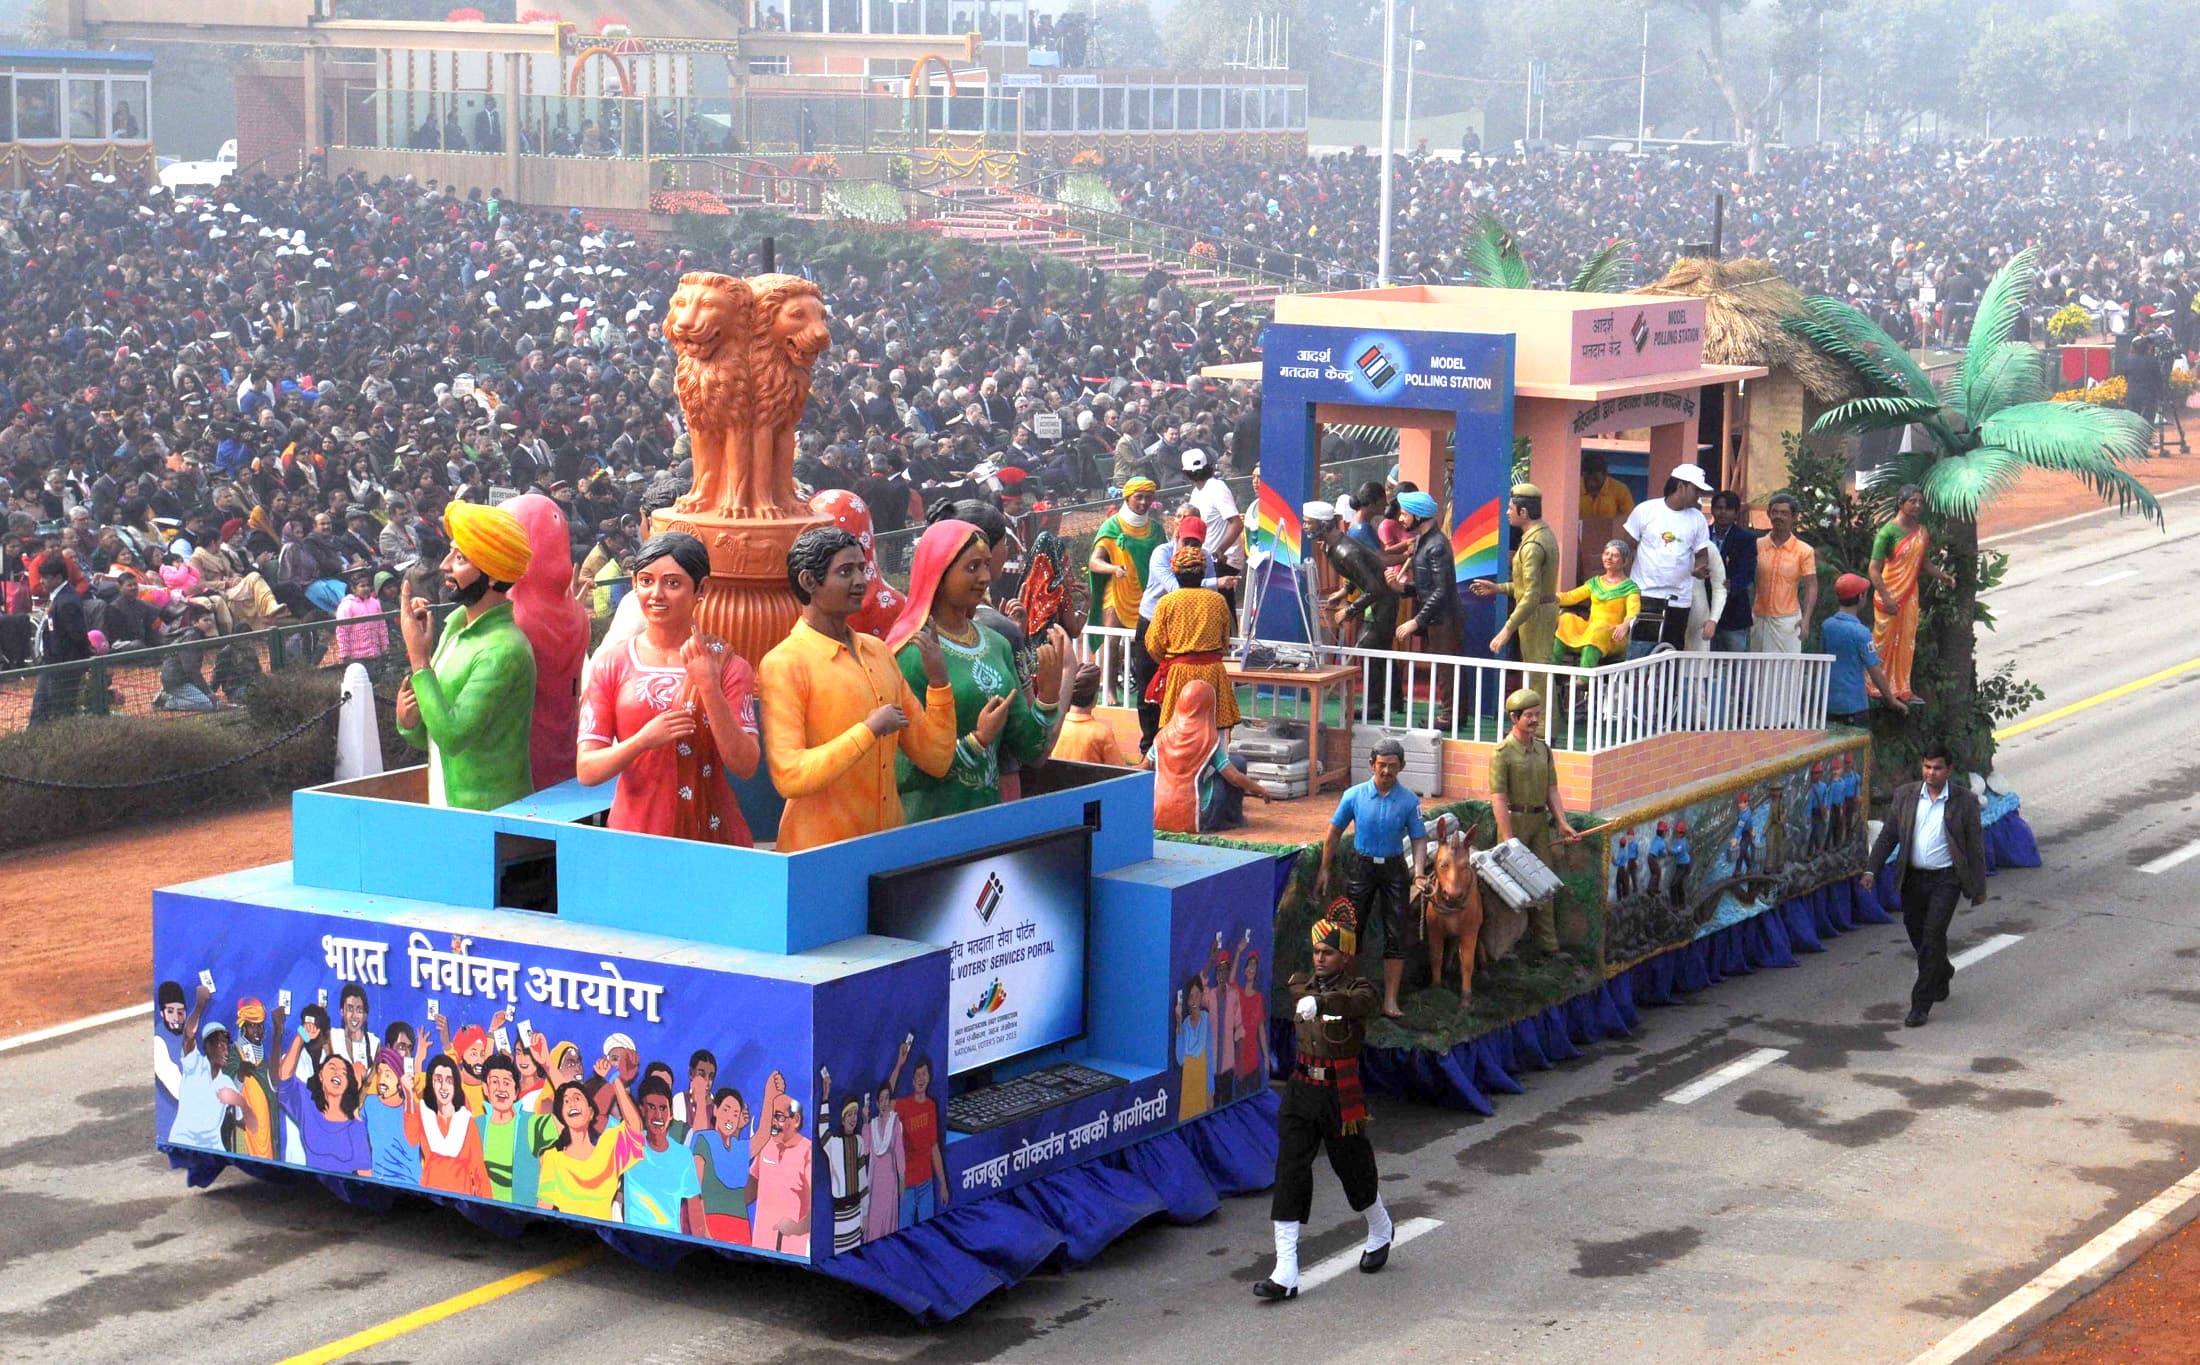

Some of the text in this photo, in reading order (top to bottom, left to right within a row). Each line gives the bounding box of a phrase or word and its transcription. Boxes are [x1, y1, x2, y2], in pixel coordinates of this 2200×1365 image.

[1667, 309, 1686, 325] MODEL
[1653, 327, 1700, 346] POLLING STATION
[1296, 347, 1331, 363] आदर्श
[1430, 356, 1467, 370] MODEL
[1280, 365, 1354, 383] मतदान केन्द्र
[1404, 373, 1492, 390] POLLING STATION
[967, 935, 994, 957] मतदाता
[997, 926, 1013, 948] सेवा
[1016, 919, 1036, 942] पोर्टल
[990, 950, 1025, 970] SERVICES
[1027, 939, 1055, 960] PORTAL
[322, 931, 664, 1024] भारत निर्वाचन आयोग
[961, 1088, 1168, 1189] मजबूत लोकतंत्र सबकी भागीदारी
